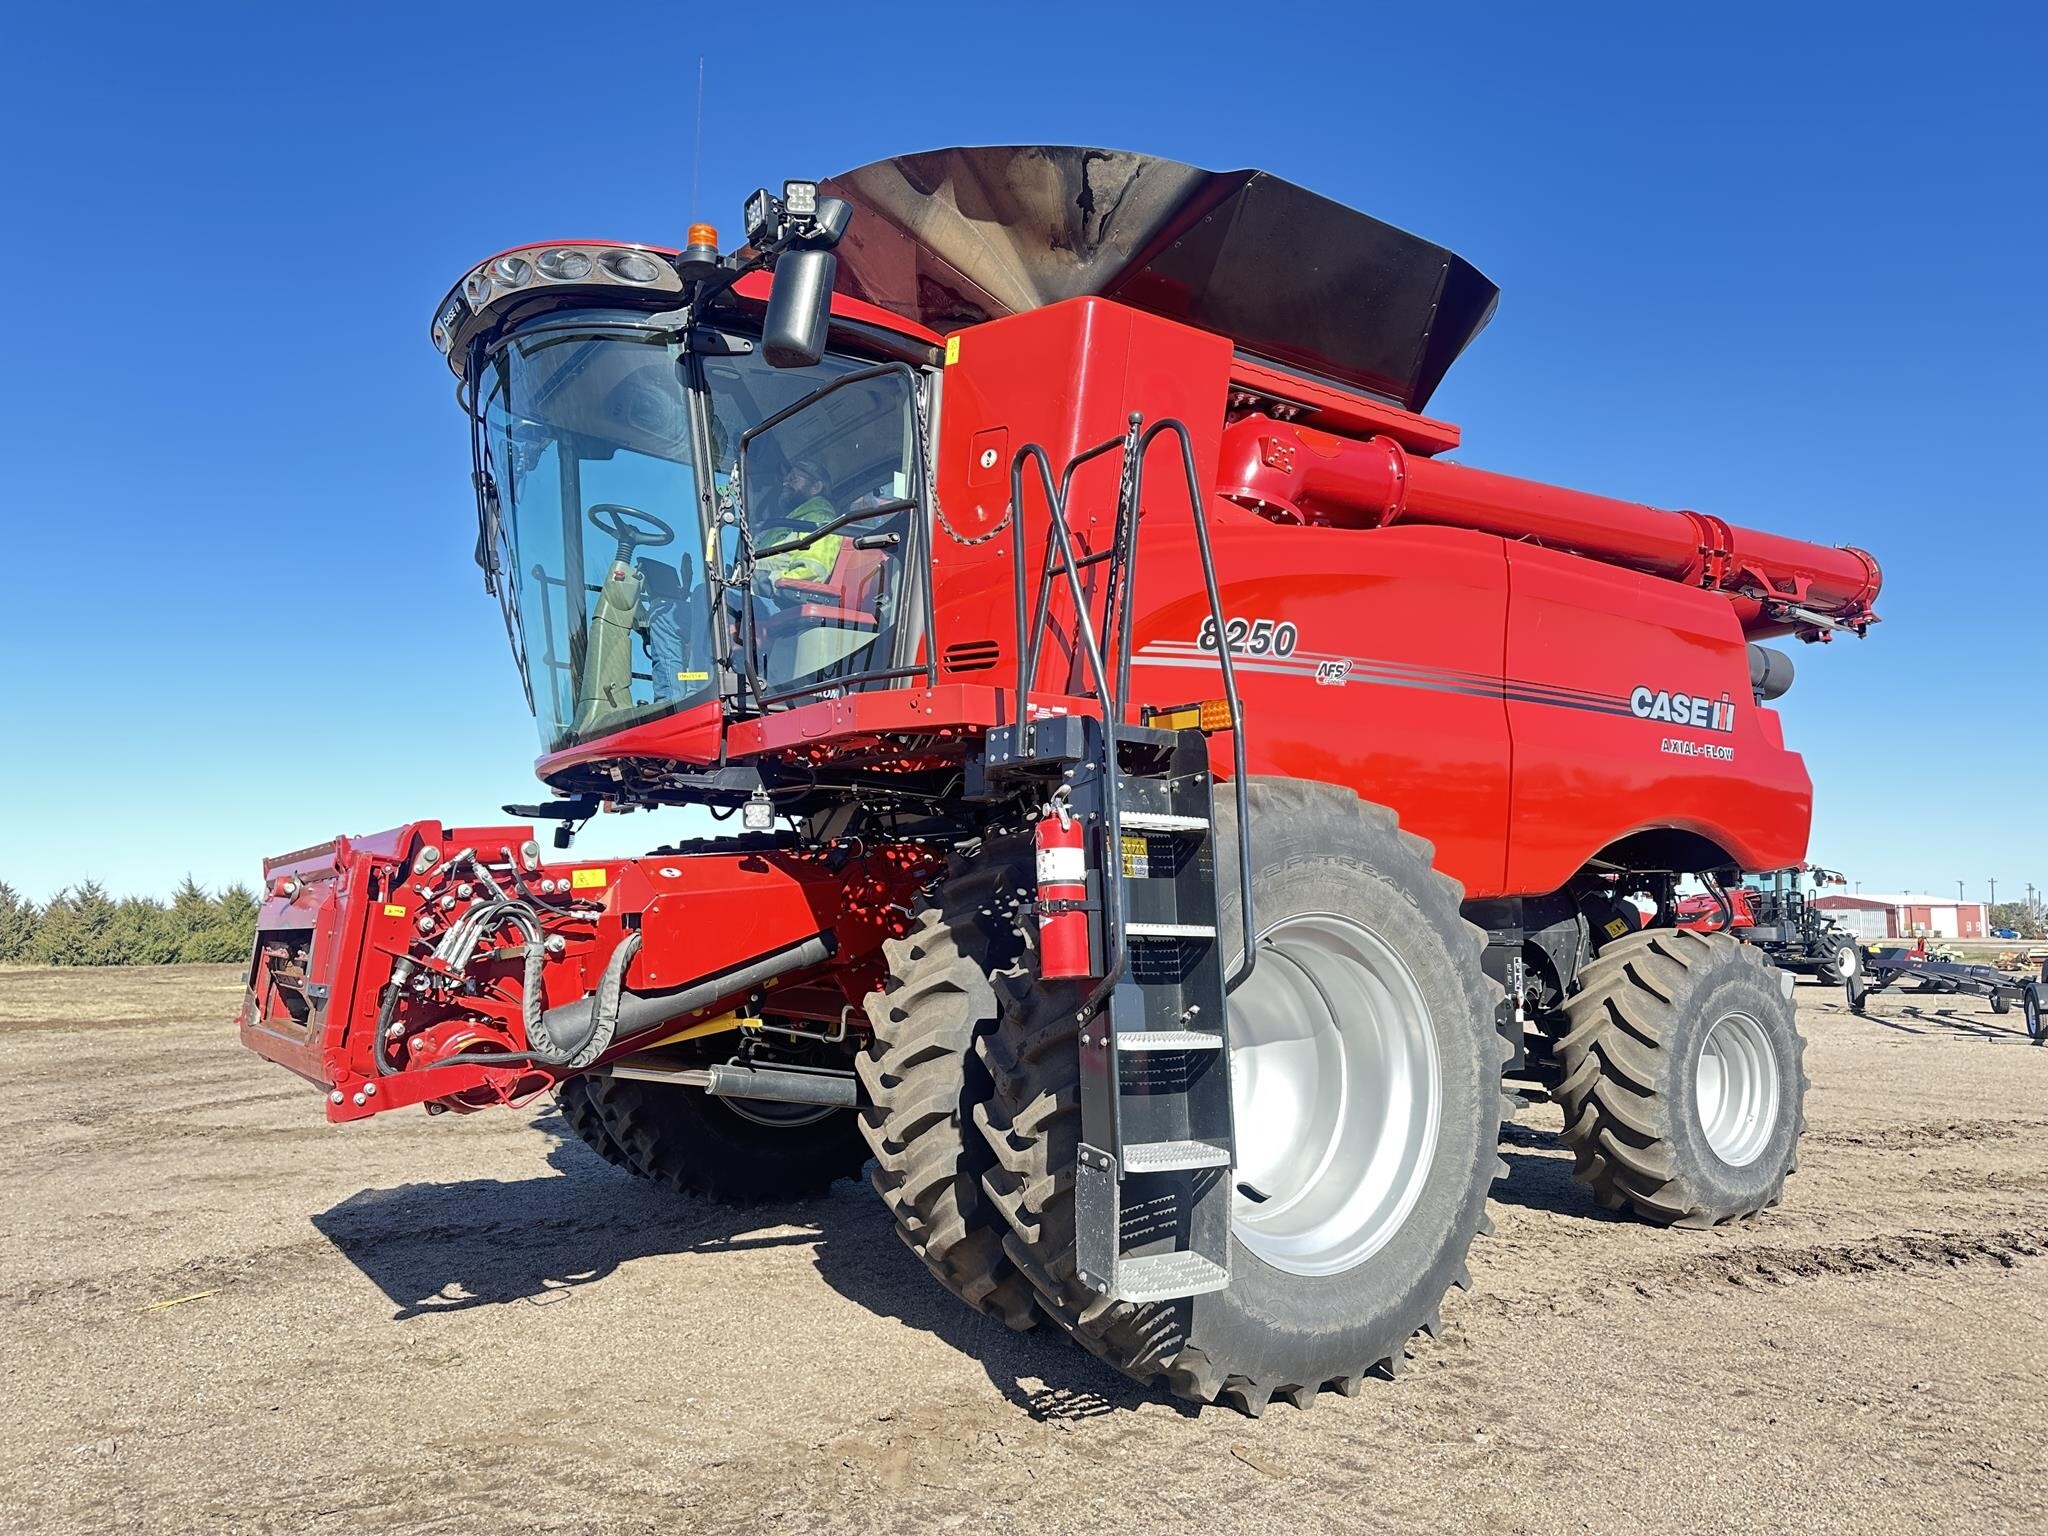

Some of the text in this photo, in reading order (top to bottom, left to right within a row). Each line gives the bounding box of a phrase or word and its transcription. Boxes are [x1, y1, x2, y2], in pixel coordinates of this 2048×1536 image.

[1198, 615, 1298, 658] 8250
[1316, 661, 1346, 678] AFS
[1630, 685, 1710, 728] CASE
[1661, 738, 1734, 761] AXIAL-FLOW
